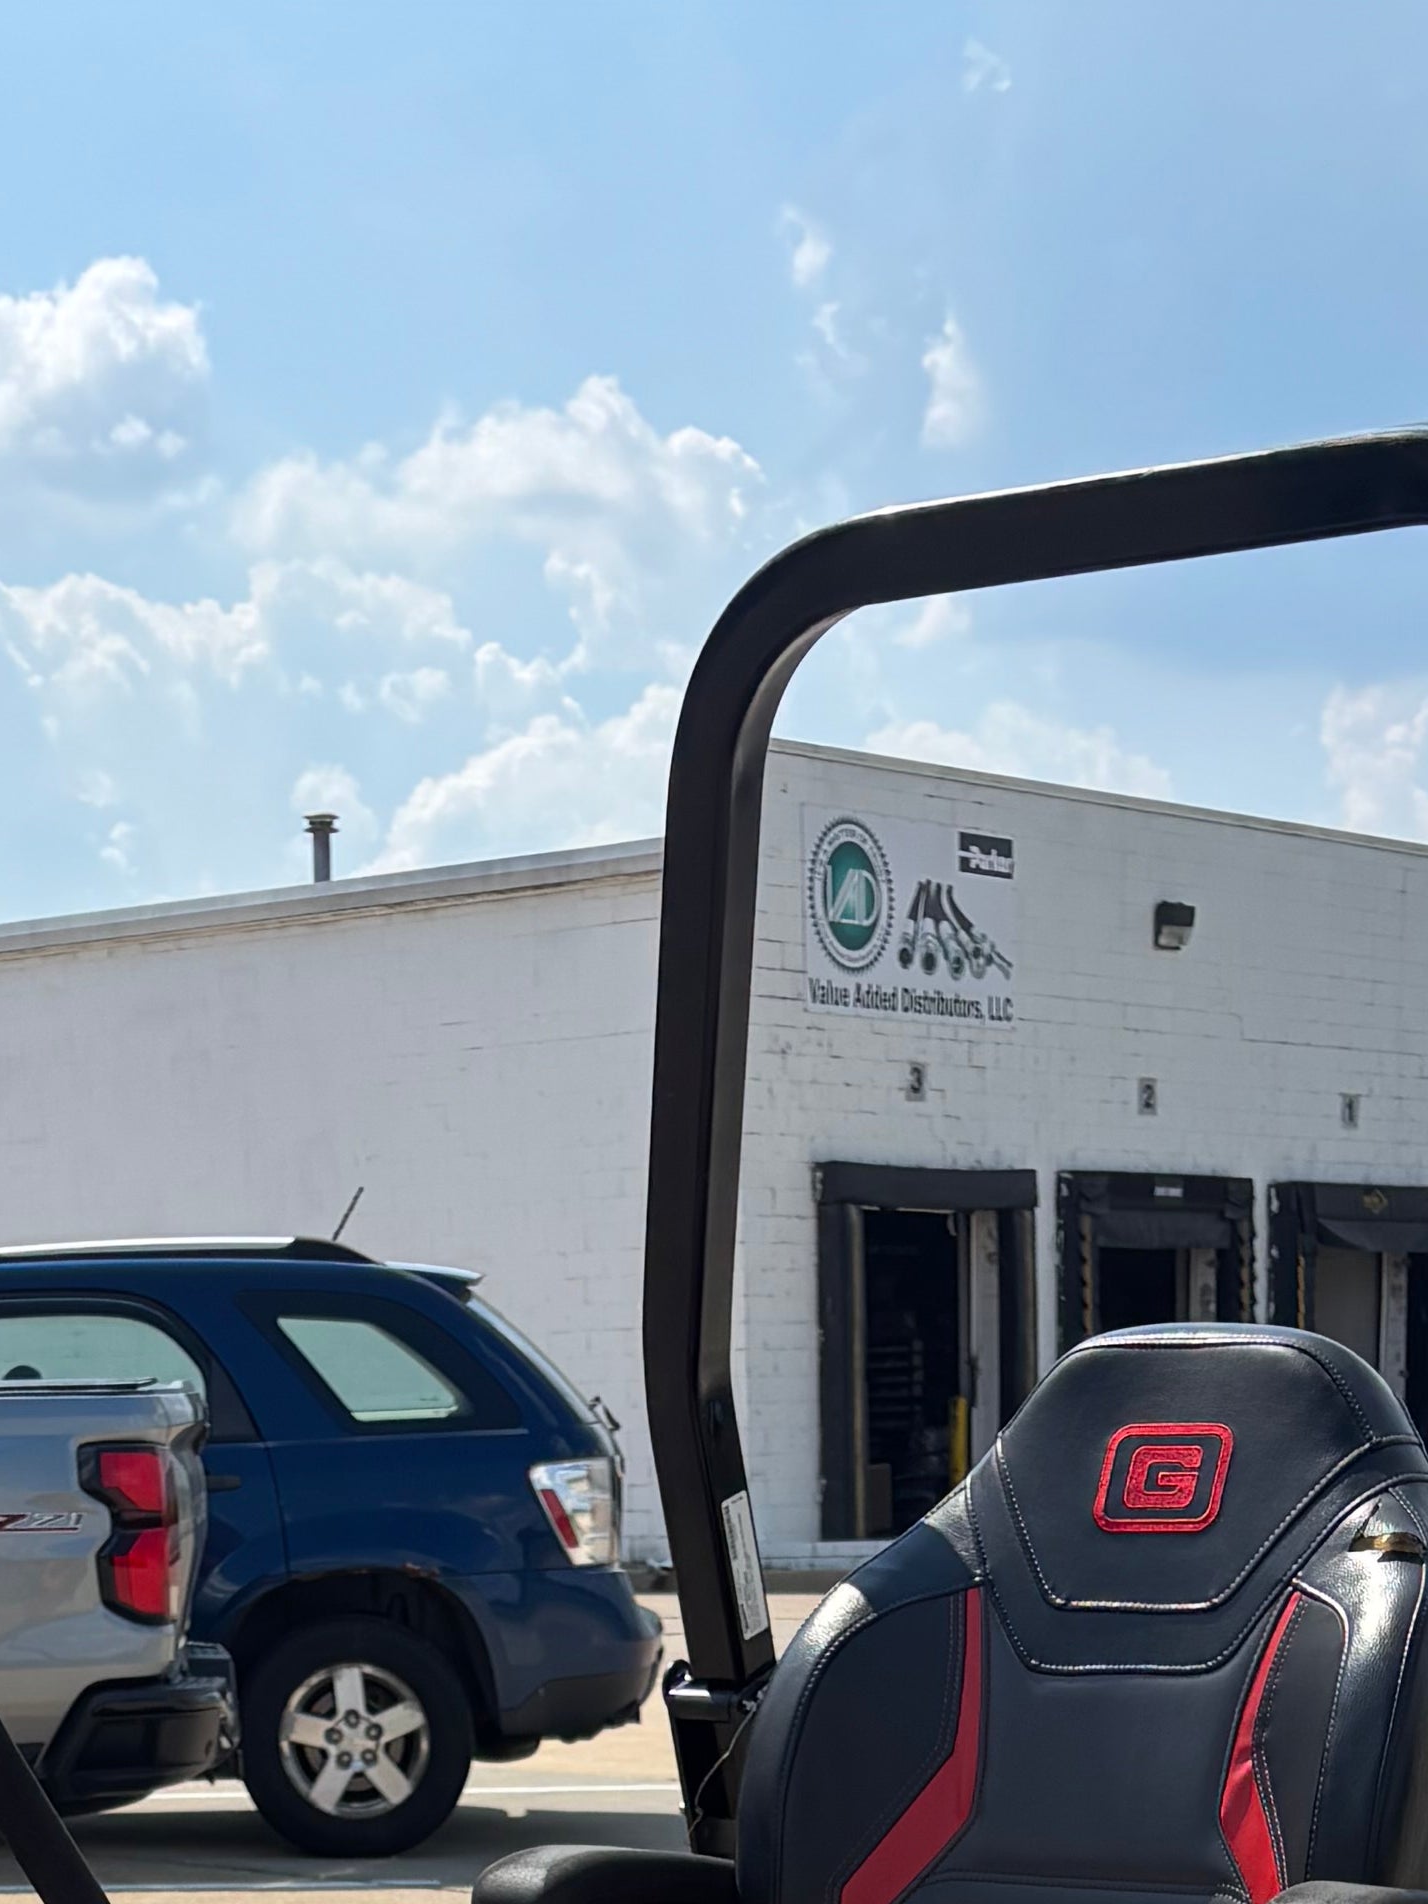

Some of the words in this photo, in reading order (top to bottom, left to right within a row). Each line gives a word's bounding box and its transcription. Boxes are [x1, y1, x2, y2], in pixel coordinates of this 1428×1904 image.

[808, 977, 851, 1008] Value
[853, 982, 898, 1012] Added
[901, 987, 986, 1025] Distributors,
[987, 995, 1014, 1022] LLC
[910, 1066, 922, 1094] 3
[1143, 1083, 1156, 1110] 2
